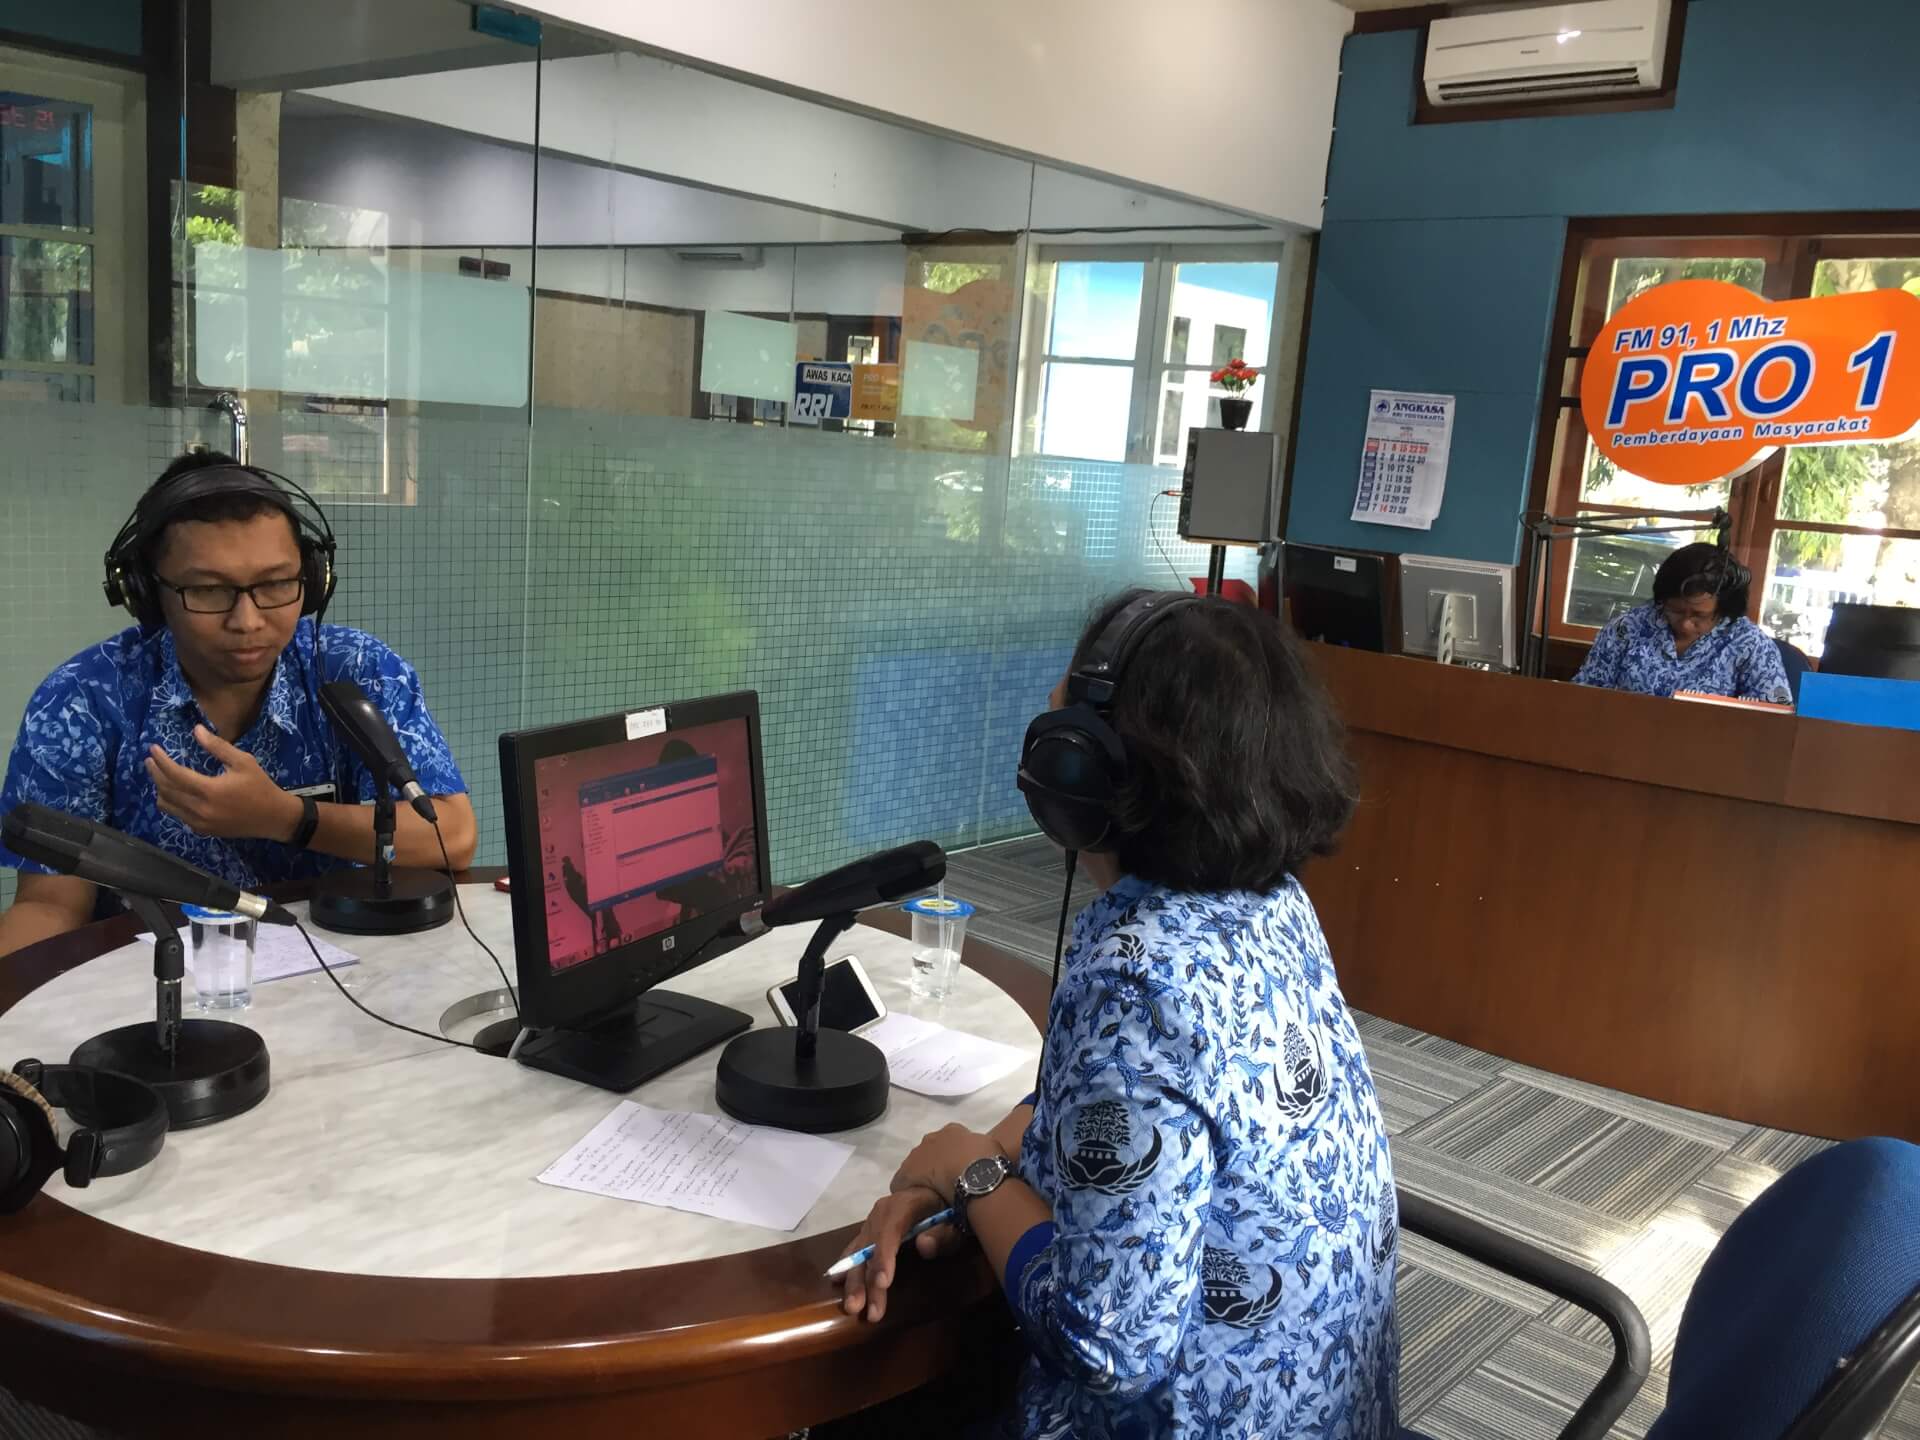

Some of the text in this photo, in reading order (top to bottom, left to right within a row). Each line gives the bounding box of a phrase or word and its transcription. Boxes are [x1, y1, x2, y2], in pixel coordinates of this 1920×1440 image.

[1615, 317, 1786, 351] FM 91, 1 Mhz
[806, 368, 852, 383] AWAS KACA
[1605, 331, 1896, 428] PRO 1
[794, 393, 834, 417] RRI
[1393, 402, 1445, 414] ANGKASA
[1613, 417, 1870, 446] Pemberdayaan Masyarakat
